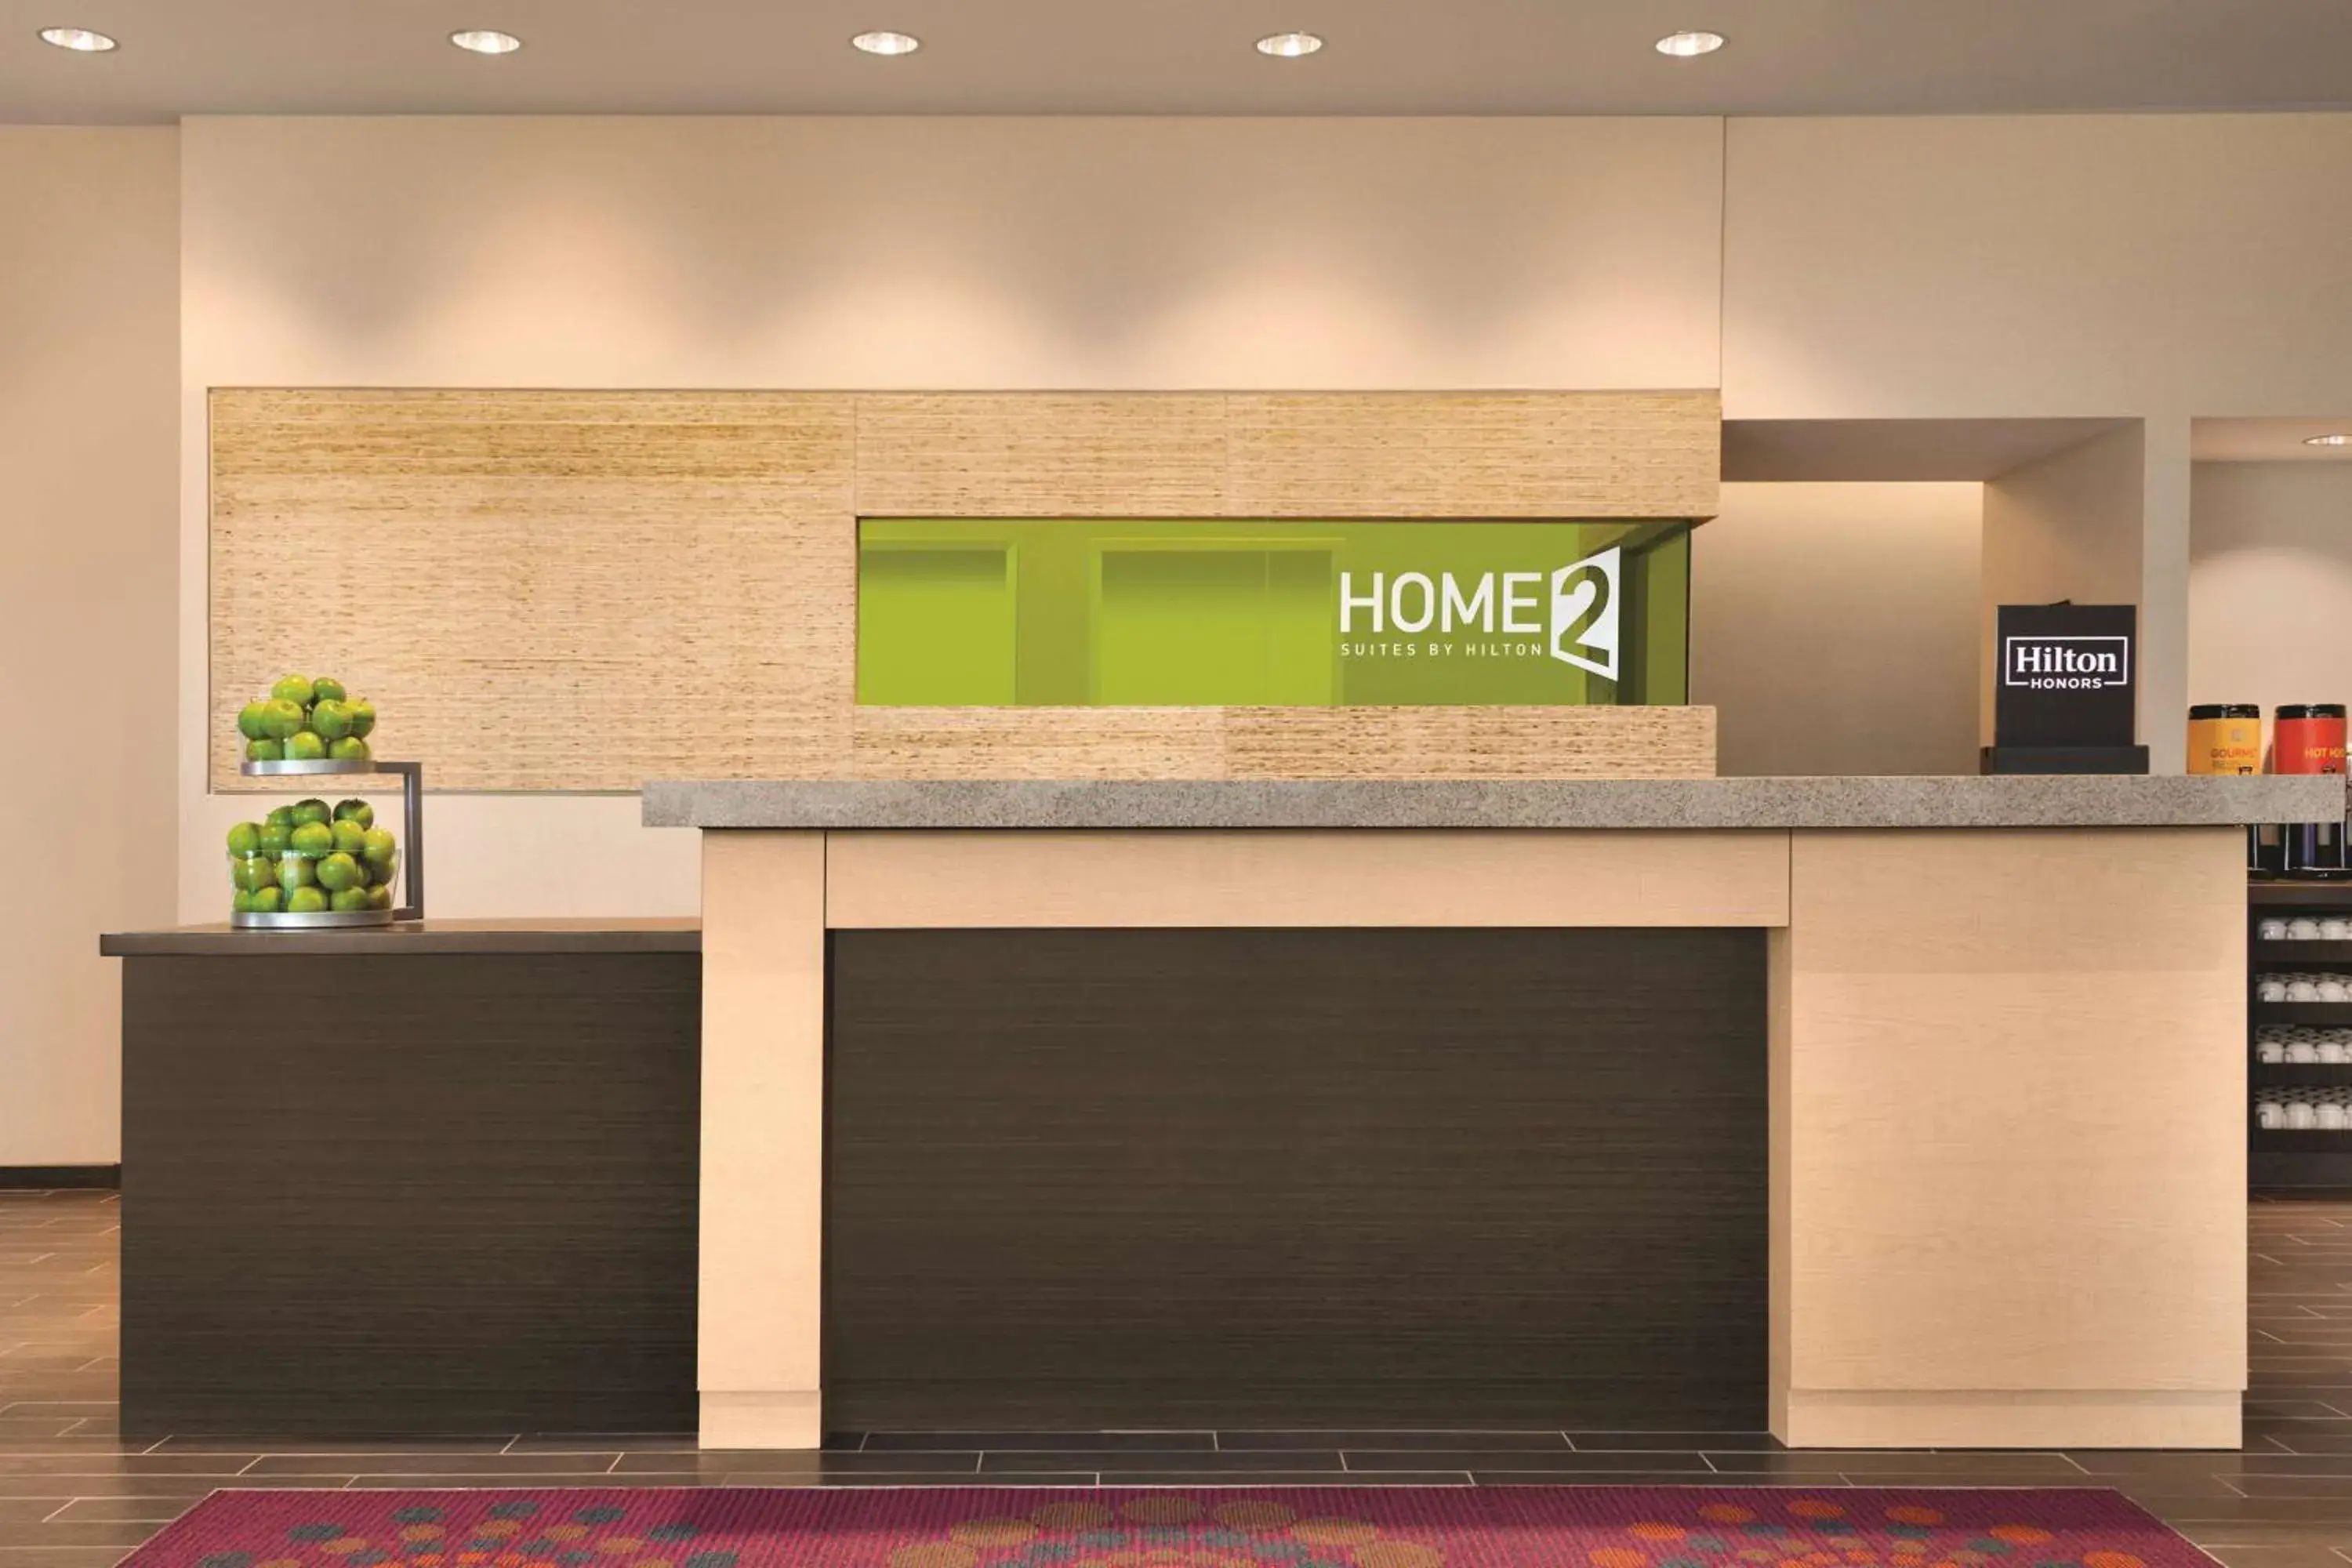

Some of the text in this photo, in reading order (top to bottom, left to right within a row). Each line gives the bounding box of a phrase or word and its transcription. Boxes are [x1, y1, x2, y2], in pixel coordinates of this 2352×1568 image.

[1340, 564, 1611, 669] HOME 2
[1341, 643, 1542, 656] SUITES BY HILTON
[2016, 646, 2118, 673] Hilton
[2031, 677, 2102, 689] HONORS
